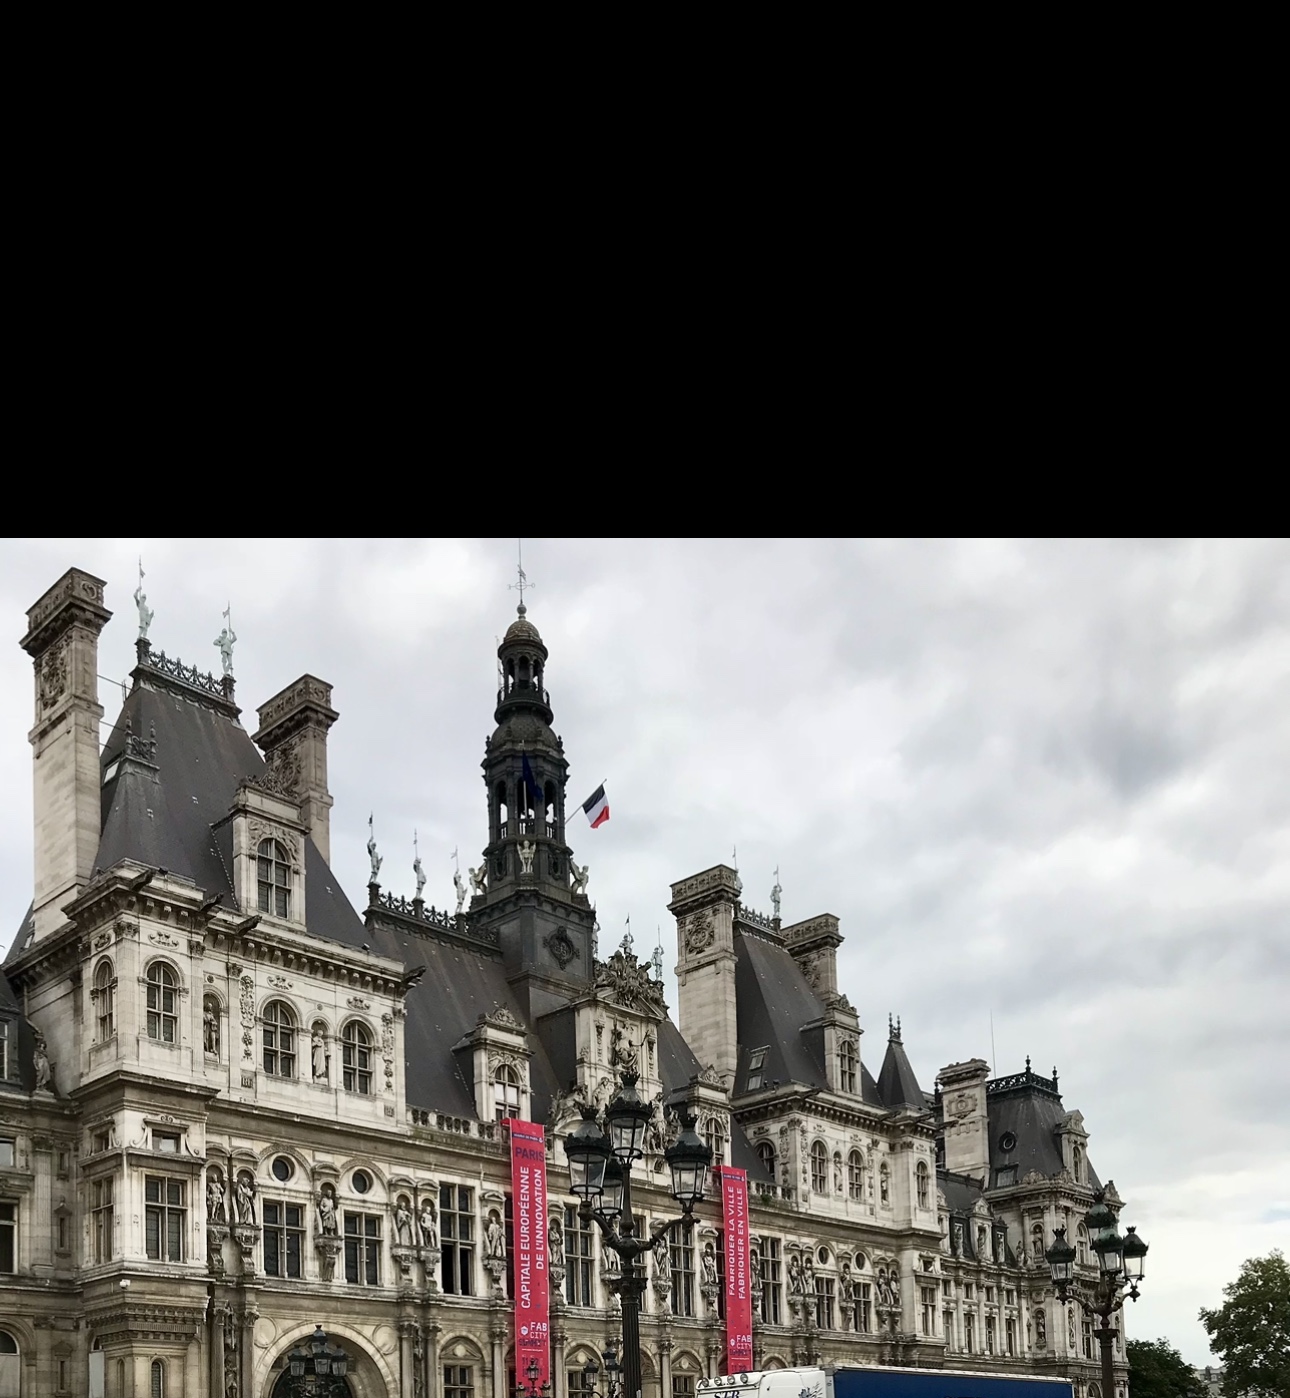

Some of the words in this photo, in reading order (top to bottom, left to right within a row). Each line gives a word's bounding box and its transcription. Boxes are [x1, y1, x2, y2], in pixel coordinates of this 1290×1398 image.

[515, 1146, 545, 1162] PARIS
[518, 1166, 530, 1250] EUROPÉENNE
[534, 1168, 544, 1250] L'INNOVATION
[728, 1218, 735, 1231] LA
[737, 1220, 744, 1235] EN
[536, 1253, 544, 1270] DE
[737, 1238, 745, 1299] FABRIQUER
[520, 1253, 531, 1309] CAPITALE
[530, 1321, 548, 1332] FAB
[530, 1331, 548, 1339] CITY
[736, 1334, 752, 1343] FAB
